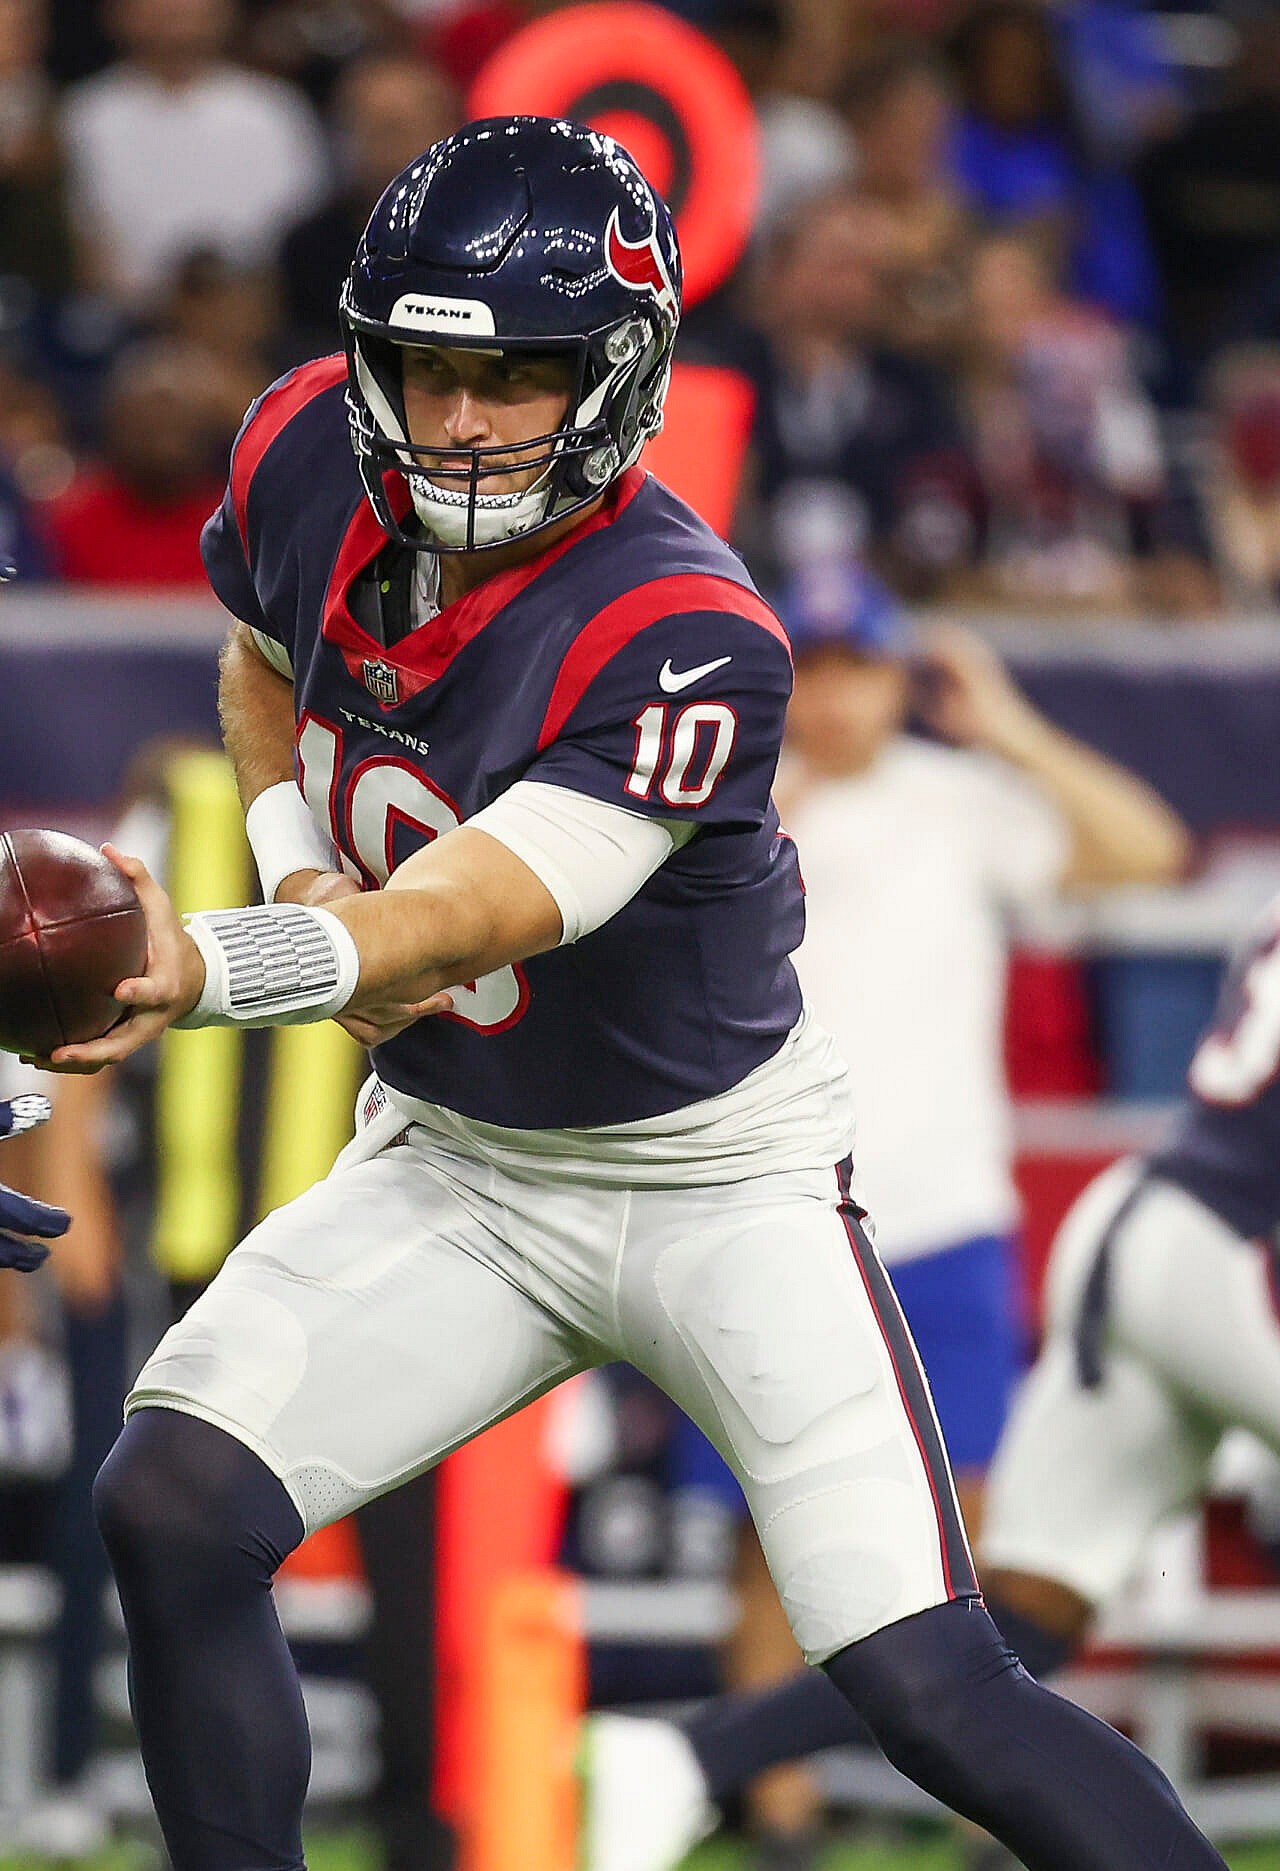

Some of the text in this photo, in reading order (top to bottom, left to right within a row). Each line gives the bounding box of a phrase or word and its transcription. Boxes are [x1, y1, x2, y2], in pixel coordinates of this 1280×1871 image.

[404, 303, 472, 320] TEXANS
[338, 706, 431, 756] TEXANS
[623, 700, 740, 808] 10
